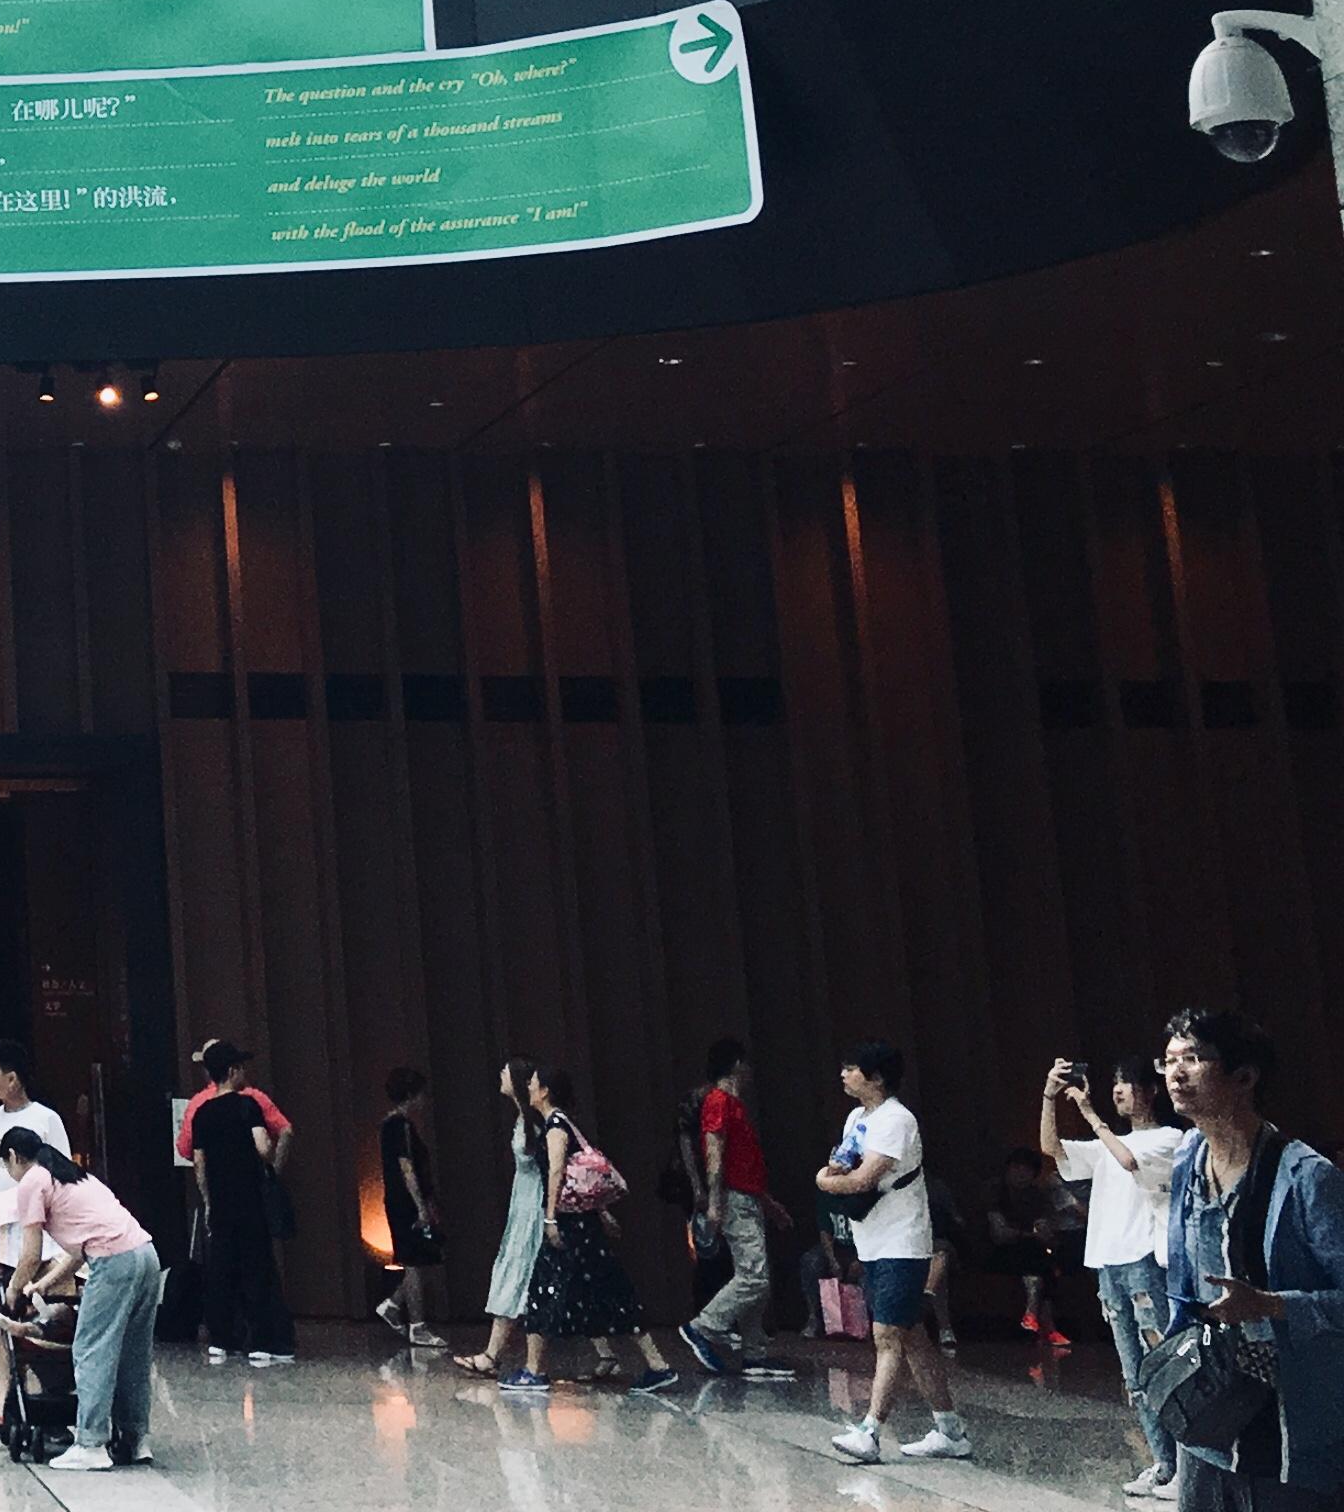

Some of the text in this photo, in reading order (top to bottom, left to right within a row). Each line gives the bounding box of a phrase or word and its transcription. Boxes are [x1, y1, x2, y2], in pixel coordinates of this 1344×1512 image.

[264, 86, 295, 103] The
[297, 84, 366, 105] question
[370, 78, 405, 96] and
[408, 77, 434, 93] the
[437, 79, 465, 94] cry
[265, 111, 562, 147] melt into tears of a thousand streams
[266, 166, 441, 193] and deluge the world
[271, 224, 309, 241] with
[313, 222, 339, 239] the
[338, 218, 385, 242] flood
[388, 217, 409, 238] of
[409, 216, 436, 233] the
[439, 213, 520, 231] assurance
